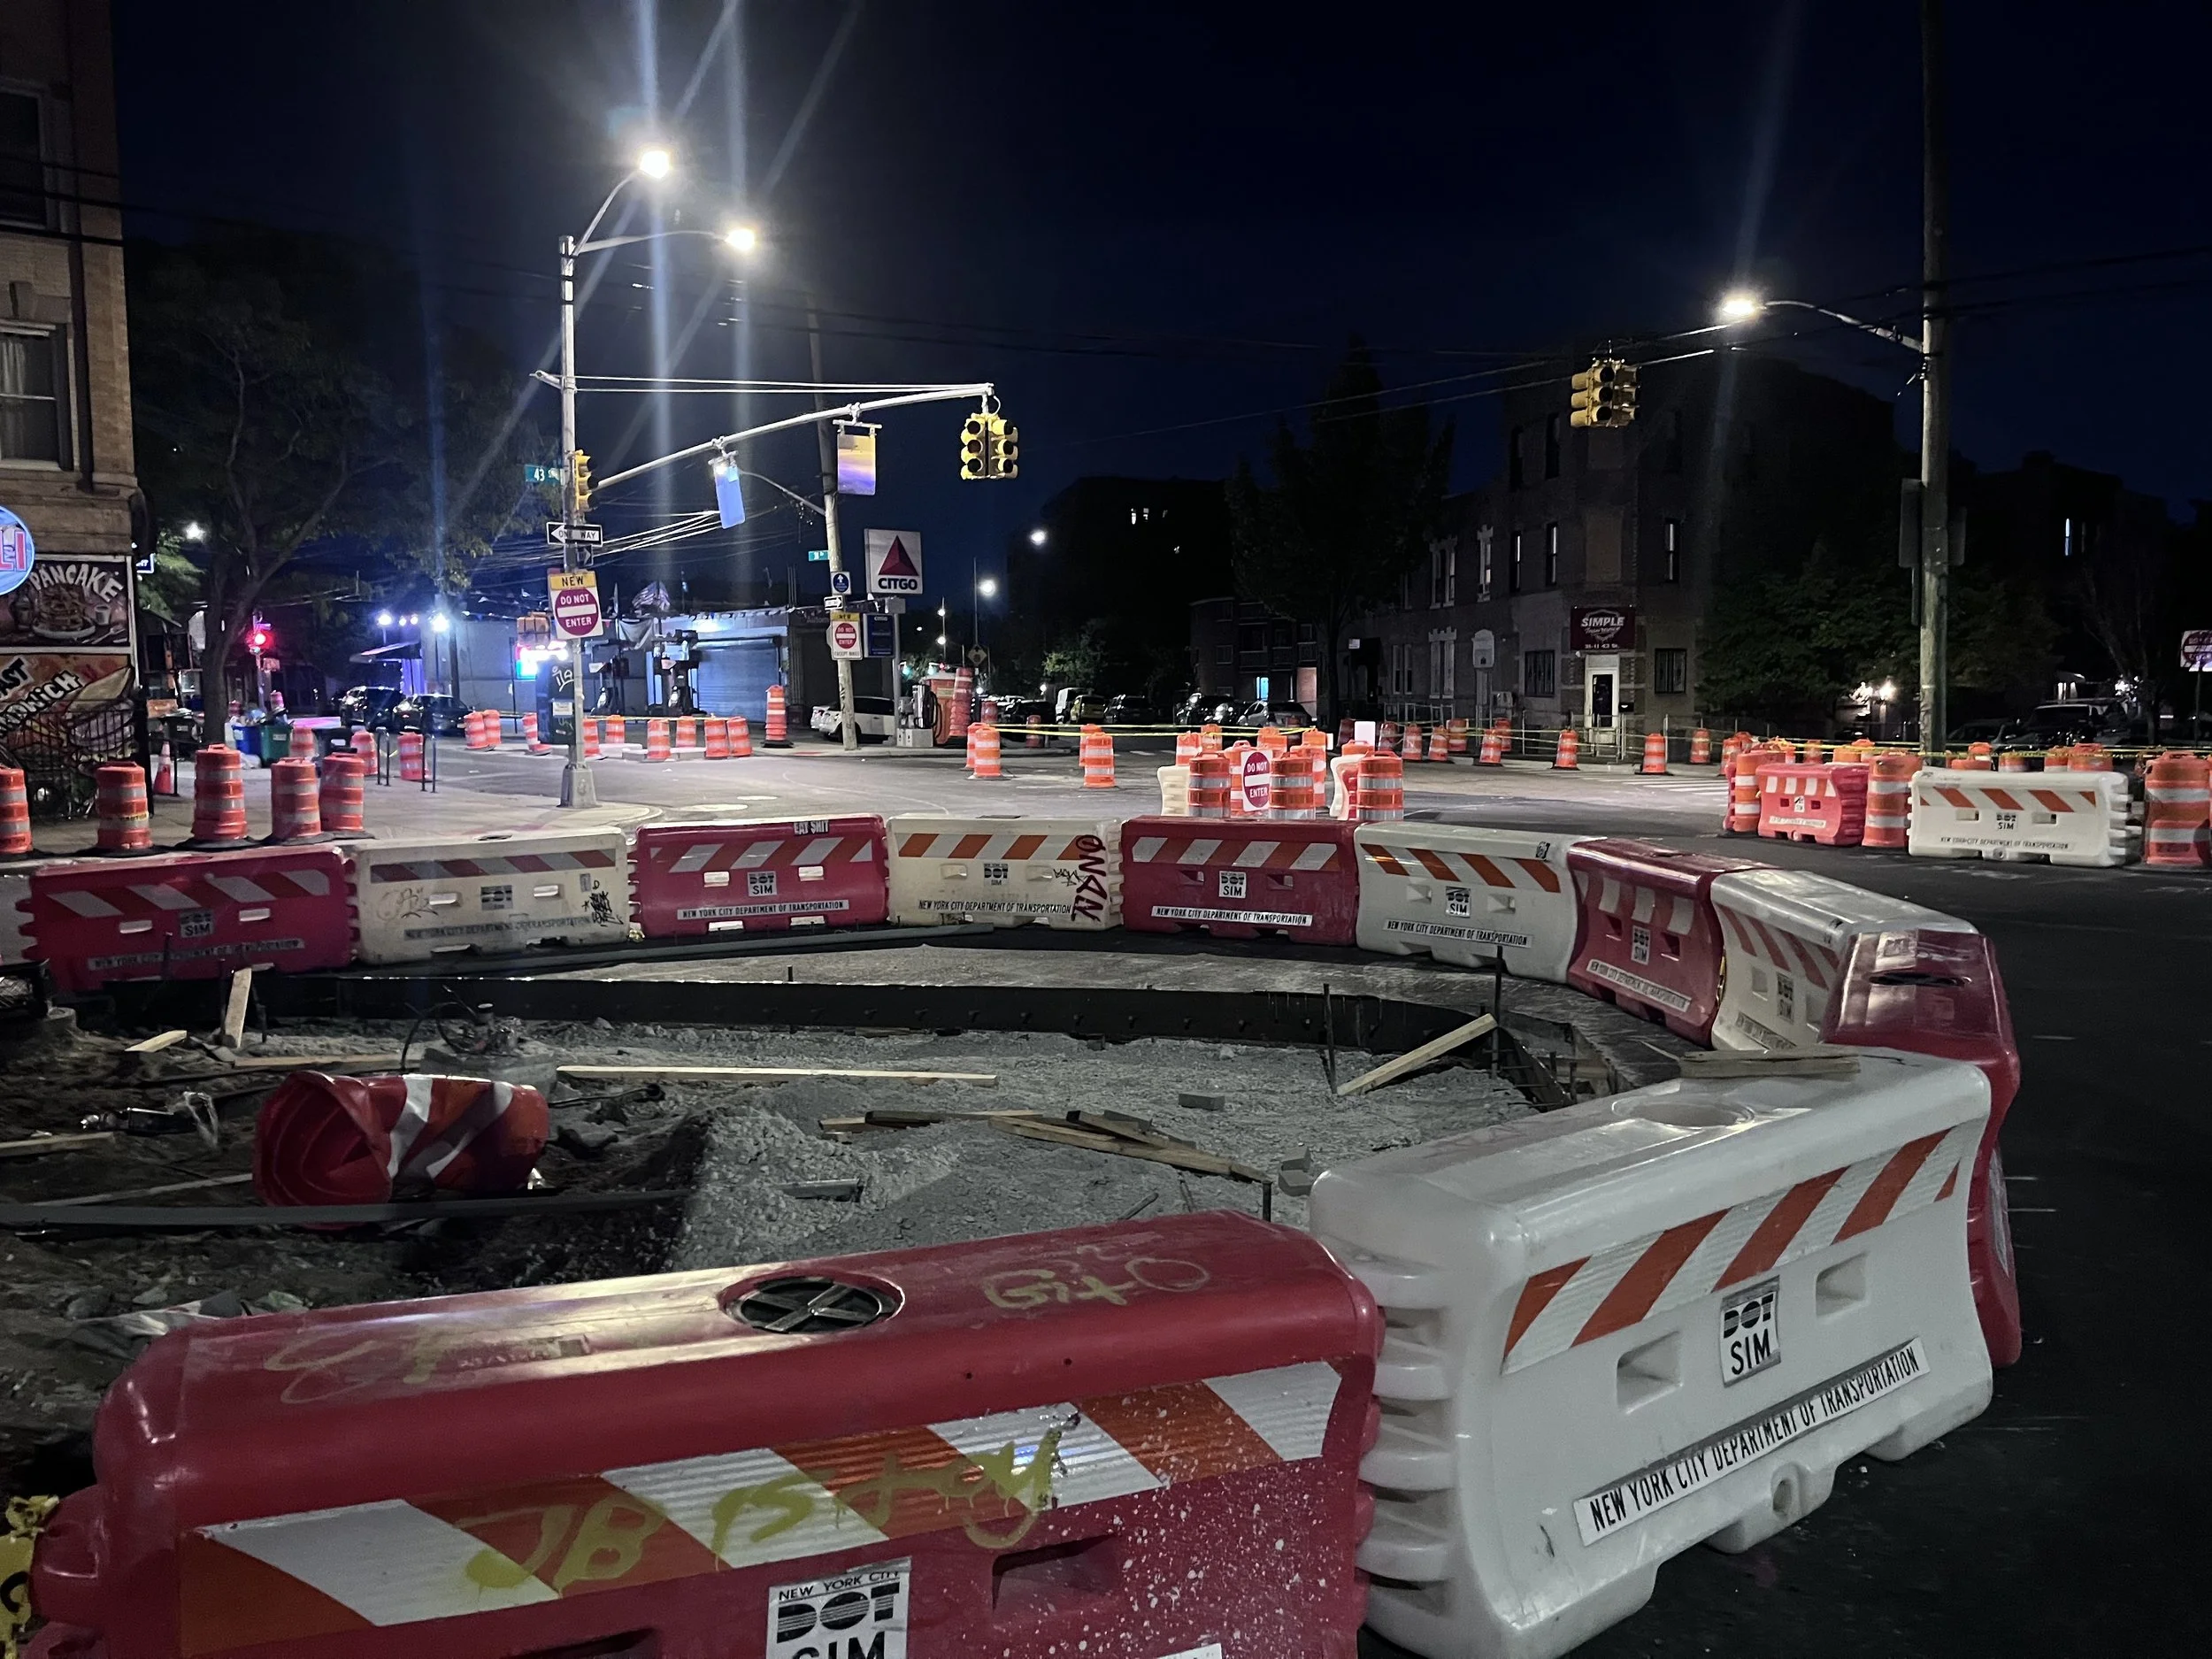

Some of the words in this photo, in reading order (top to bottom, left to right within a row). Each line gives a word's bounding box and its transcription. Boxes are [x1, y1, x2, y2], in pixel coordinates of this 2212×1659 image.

[534, 467, 545, 481] 43
[29, 563, 124, 603] PANCAKE
[561, 576, 585, 587] NEW
[878, 578, 918, 590] CITGO
[560, 595, 572, 605] DO
[573, 593, 589, 604] NOT
[565, 616, 592, 628] ENTER
[1580, 617, 1625, 627] SIMPLE
[1247, 763, 1255, 773] DO
[1256, 762, 1267, 772] NOT
[1249, 787, 1268, 798] ENTER
[794, 821, 809, 835] EAT
[810, 819, 829, 833] SHIT
[984, 868, 1009, 879] DOT
[749, 875, 774, 885] DOT
[1221, 876, 1244, 885] DOT
[752, 885, 773, 895] SIM
[1223, 885, 1242, 896] SIM
[683, 910, 696, 918] NEW
[699, 909, 717, 918] YORK
[735, 905, 777, 915] DEPARTMENT
[788, 901, 844, 911] TRANSPORTATION
[918, 899, 932, 910] NEW
[933, 901, 949, 910] YORK
[950, 901, 964, 910] CITY
[964, 901, 1006, 912] DEPARTMENT
[1007, 902, 1016, 912] OF
[1017, 902, 1071, 914] TRANSPORTATION
[1449, 903, 1468, 914] SIM
[1171, 908, 1186, 917] YORK
[1203, 910, 1241, 920] DEPARTMENT
[1243, 912, 1251, 921] OF
[1253, 913, 1307, 924] TRANSPORTATION
[185, 924, 211, 936] SIM
[1387, 920, 1400, 929] NEW
[1400, 922, 1414, 931] YORK
[1416, 923, 1428, 933] CITY
[1430, 925, 1465, 937] DEPARTMENT
[1466, 929, 1474, 938] OF
[1475, 930, 1527, 946] TRANSPORTATION
[1724, 1294, 1774, 1339] DOT
[1731, 1329, 1770, 1375] SIM
[1590, 1491, 1626, 1532] NEW
[1629, 1471, 1674, 1513] YORK
[1676, 1453, 1709, 1489] CITY
[1711, 1412, 1798, 1472] DEPARTMENT
[1800, 1400, 1816, 1427] OF
[1819, 1347, 1920, 1417] TRANSPORTATION
[779, 1585, 814, 1601] NEW
[823, 1575, 863, 1592] YORK
[776, 1582, 901, 1644] DOT
